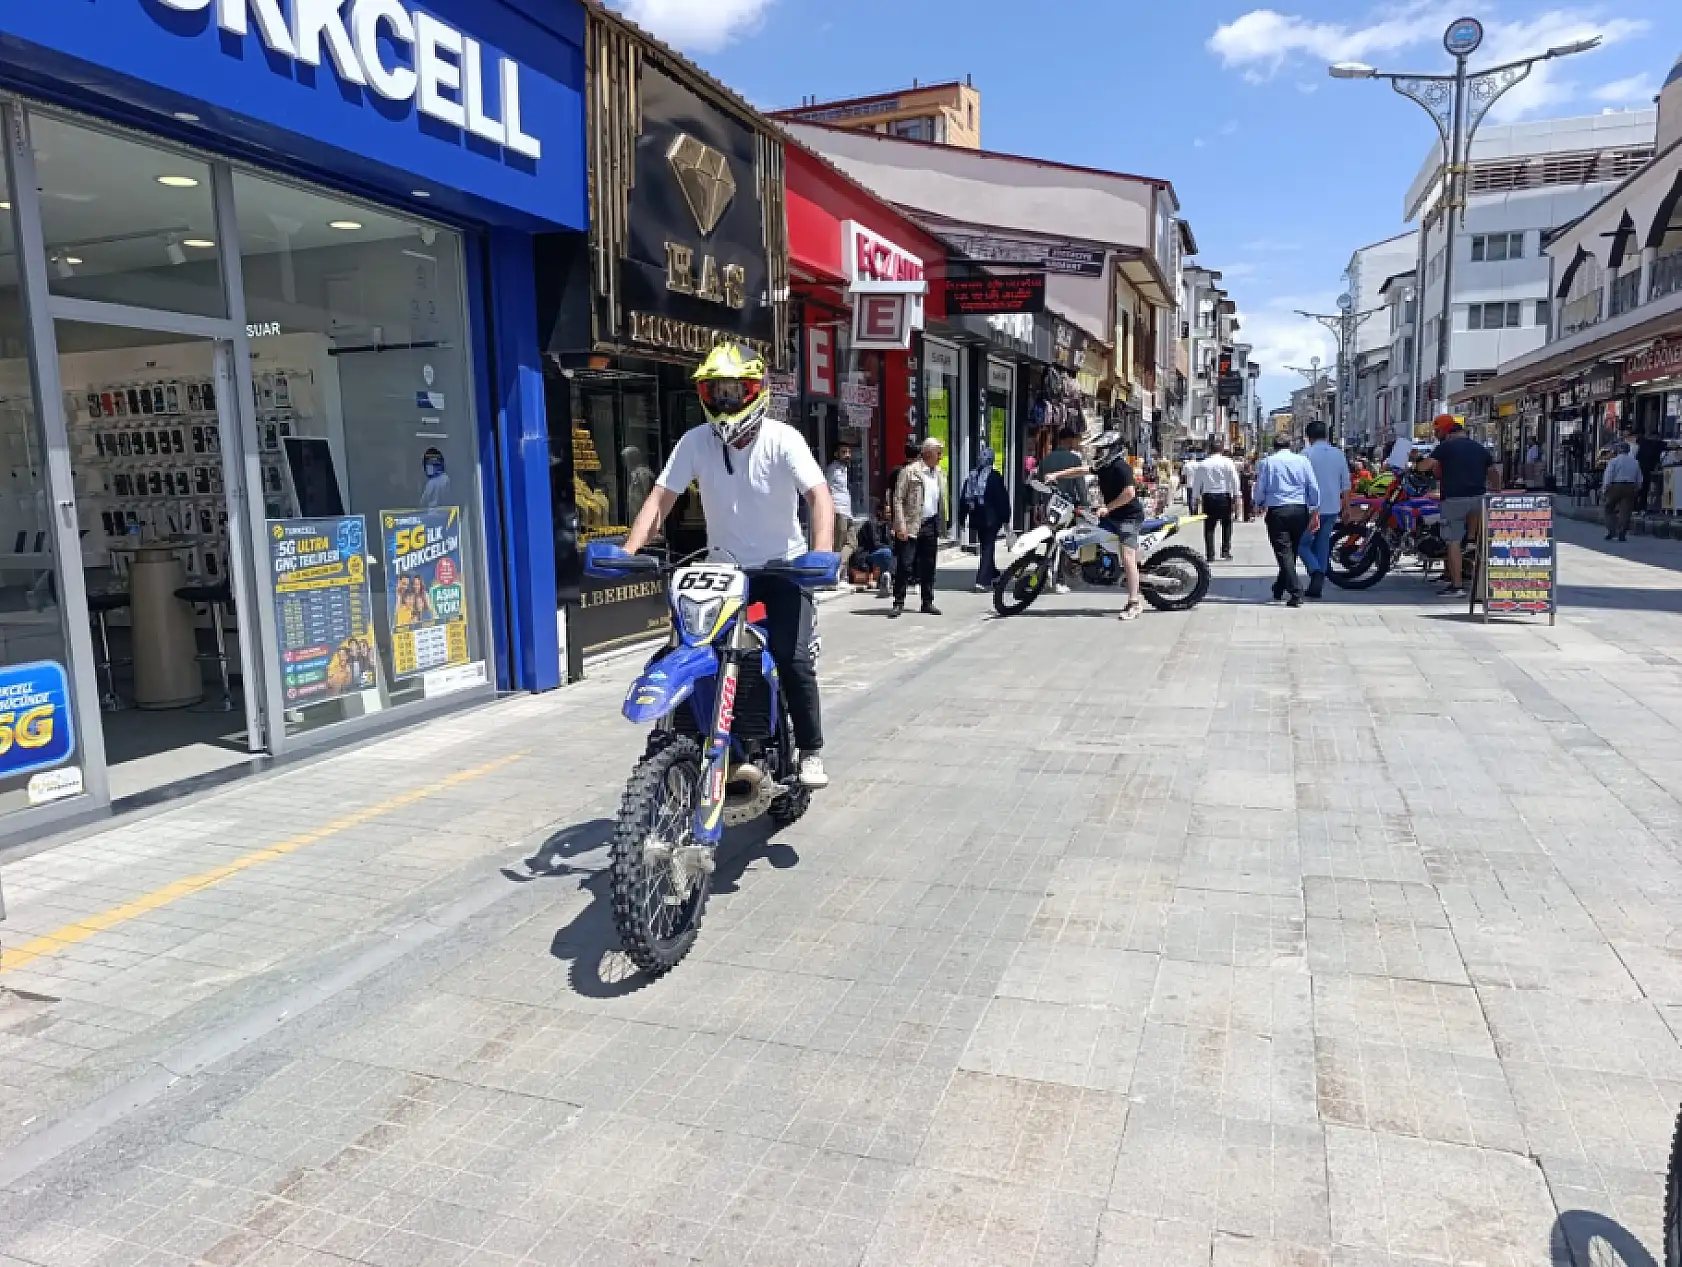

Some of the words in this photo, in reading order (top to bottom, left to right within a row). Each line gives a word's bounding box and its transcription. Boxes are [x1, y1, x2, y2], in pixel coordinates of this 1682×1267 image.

[664, 242, 744, 308] HAS
[868, 299, 896, 335] E
[810, 329, 830, 393] E
[277, 539, 296, 557] 5G
[297, 536, 330, 553] ULTRA
[395, 525, 425, 555] 5G
[677, 572, 735, 592] 653
